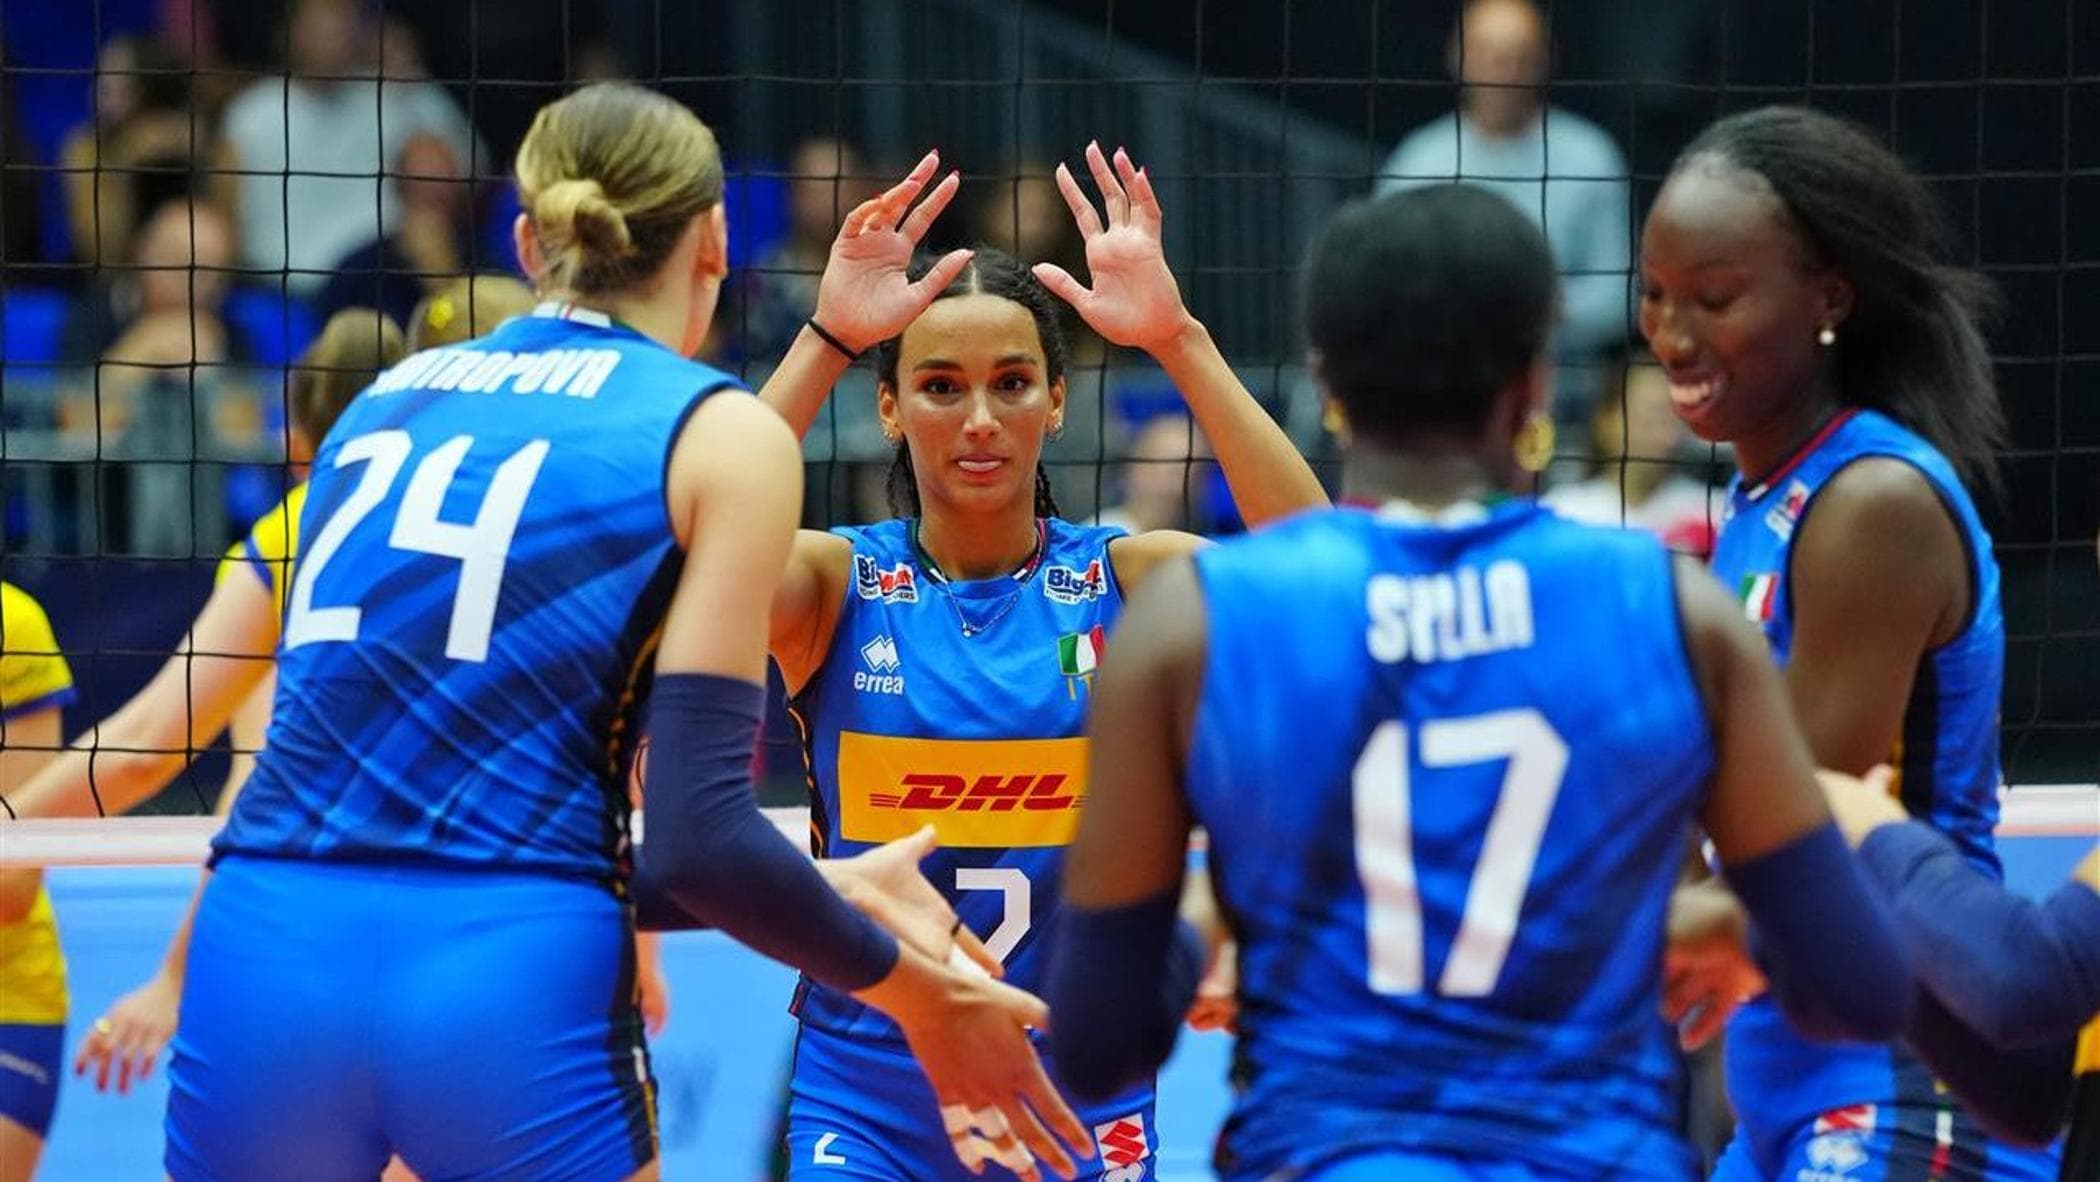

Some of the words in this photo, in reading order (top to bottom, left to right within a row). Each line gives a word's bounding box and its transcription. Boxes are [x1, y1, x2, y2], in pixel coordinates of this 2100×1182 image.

[285, 429, 550, 663] 24
[900, 774, 1074, 812] DHL
[1352, 708, 1571, 997] 17
